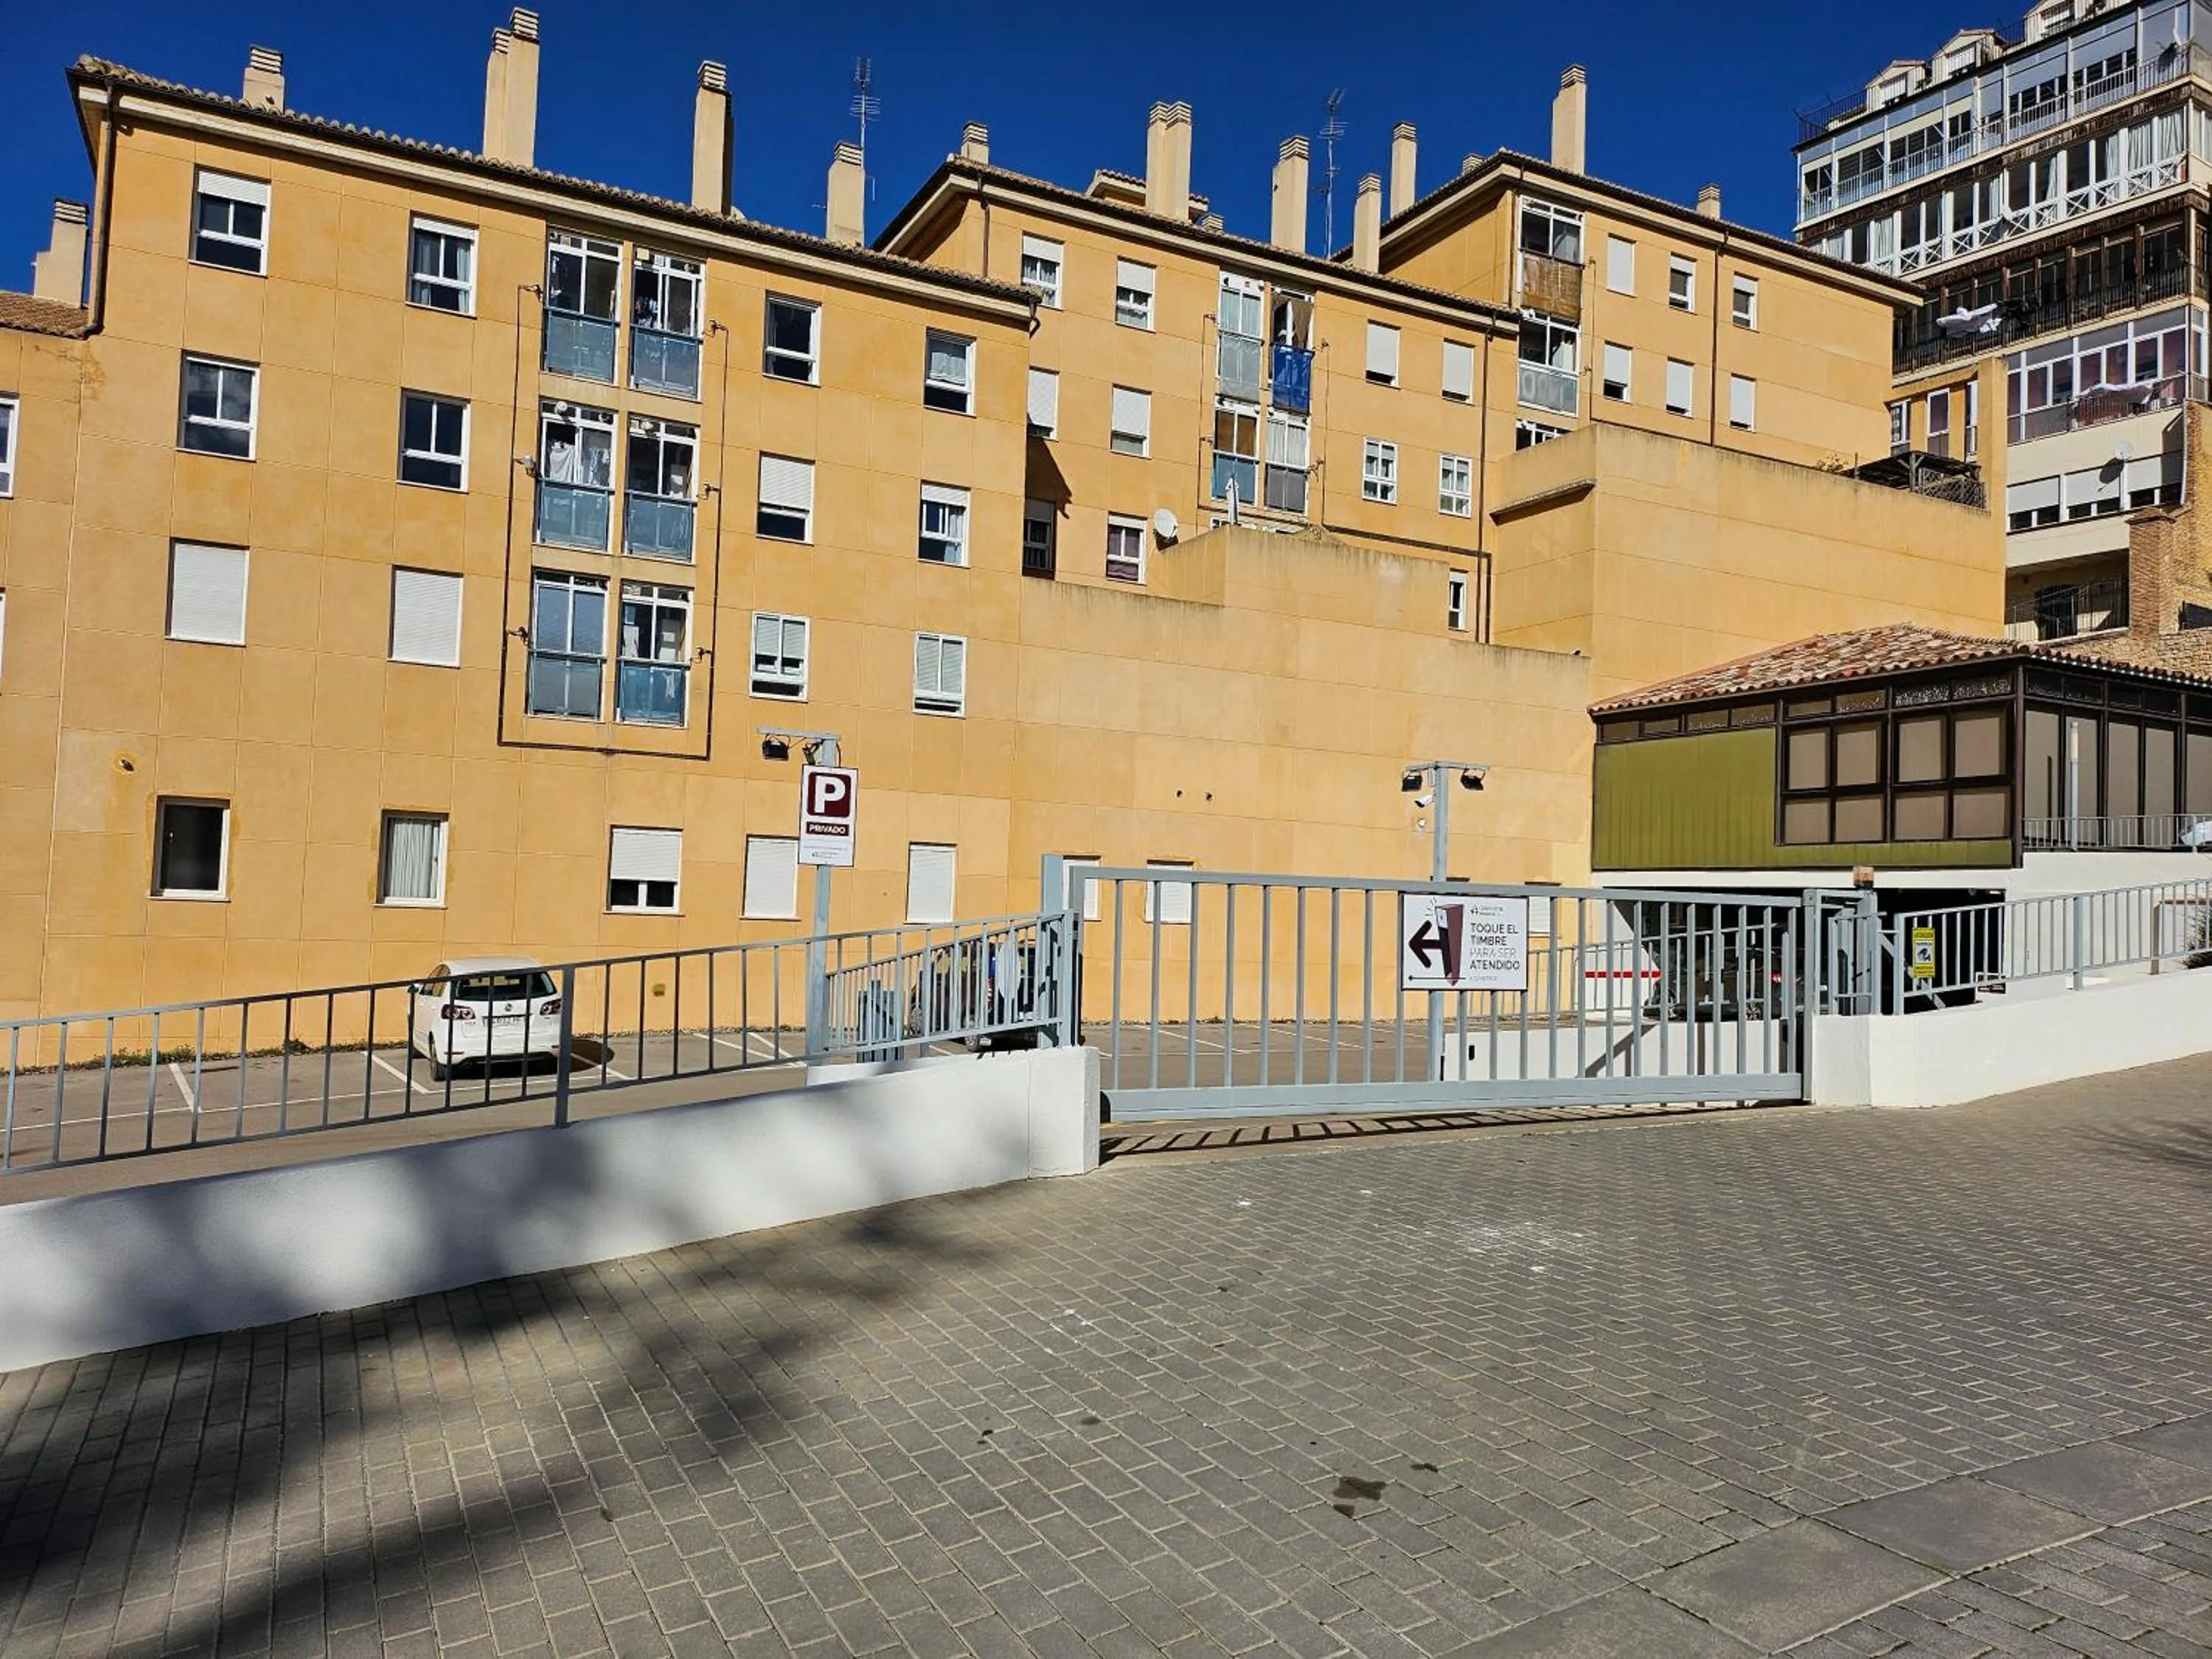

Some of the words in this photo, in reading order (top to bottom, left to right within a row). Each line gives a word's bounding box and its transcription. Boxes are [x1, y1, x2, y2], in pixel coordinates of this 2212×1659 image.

[814, 776, 846, 813] P
[809, 824, 846, 834] PRIVADO
[1470, 922, 1505, 934] TOQUE
[1506, 924, 1519, 934] EL
[1470, 934, 1507, 946] TIMBRE
[1470, 947, 1496, 958] PARA
[1498, 947, 1517, 959] SER
[1470, 960, 1520, 970] ATENDIDO
